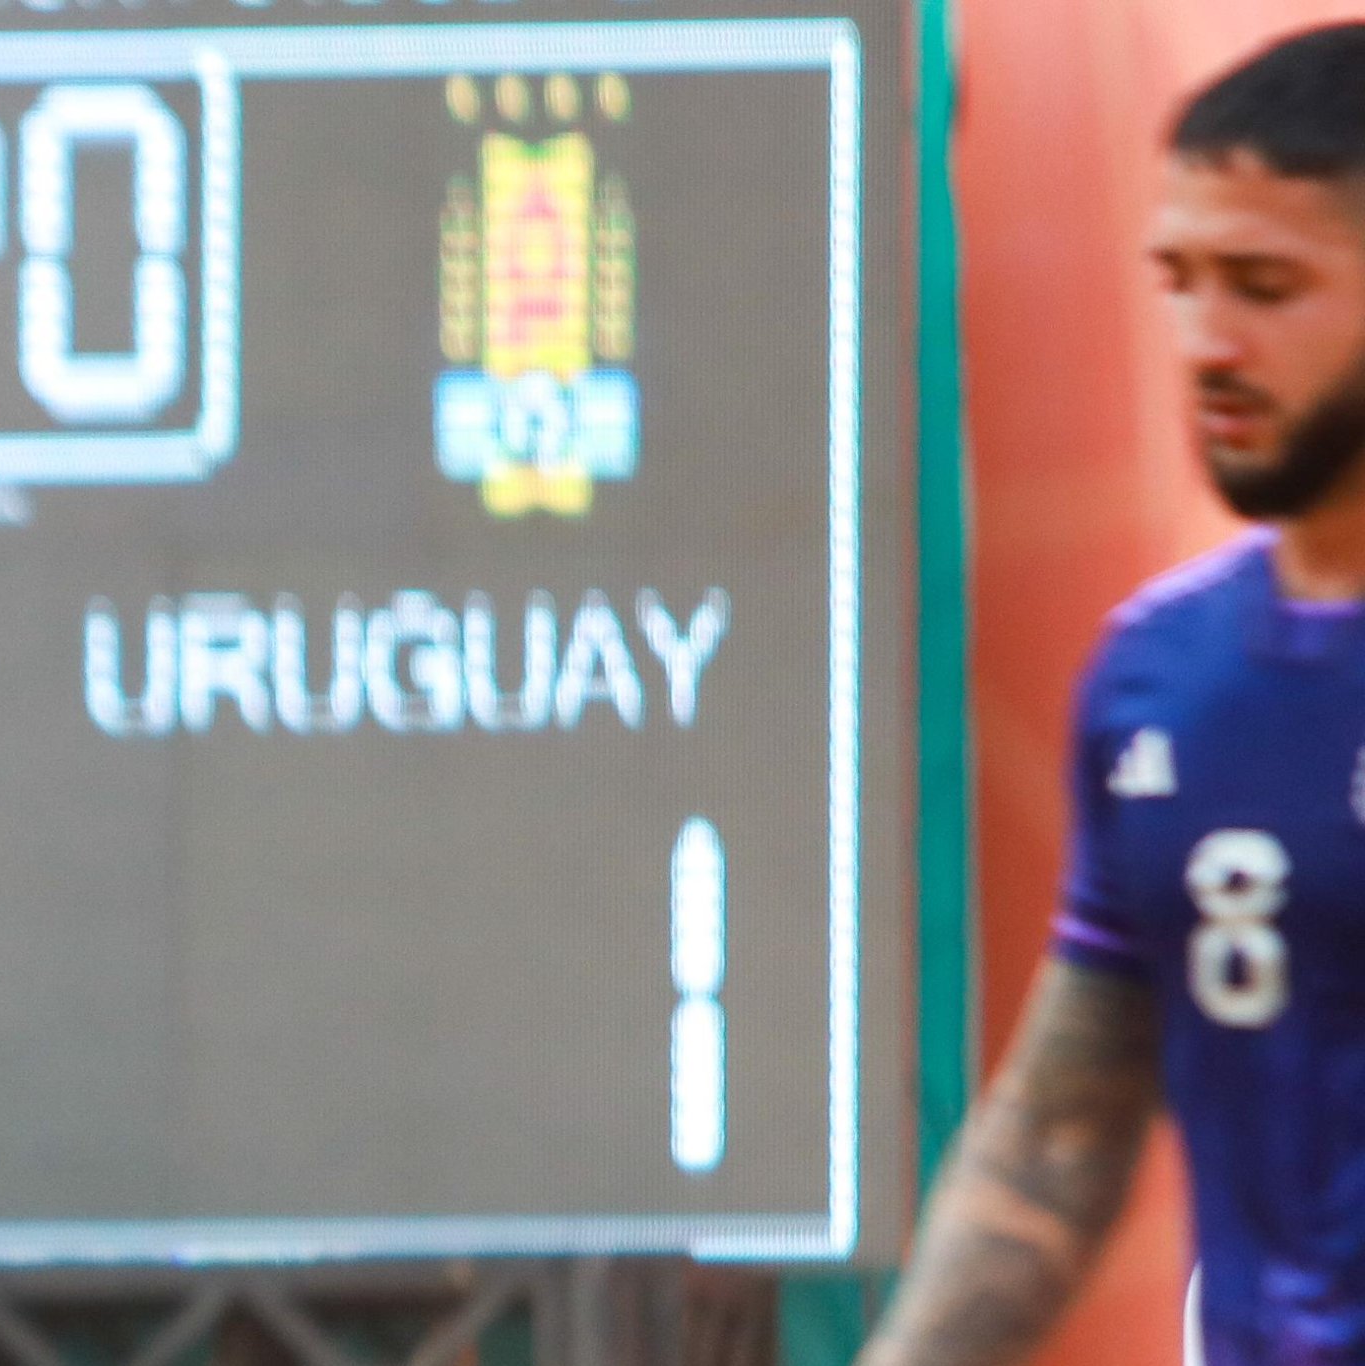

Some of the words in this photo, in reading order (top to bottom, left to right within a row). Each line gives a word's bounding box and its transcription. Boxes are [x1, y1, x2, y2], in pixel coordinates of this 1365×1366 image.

[81, 586, 732, 738] URUGUAY
[670, 815, 726, 1173] 1
[1185, 827, 1291, 1030] 8
